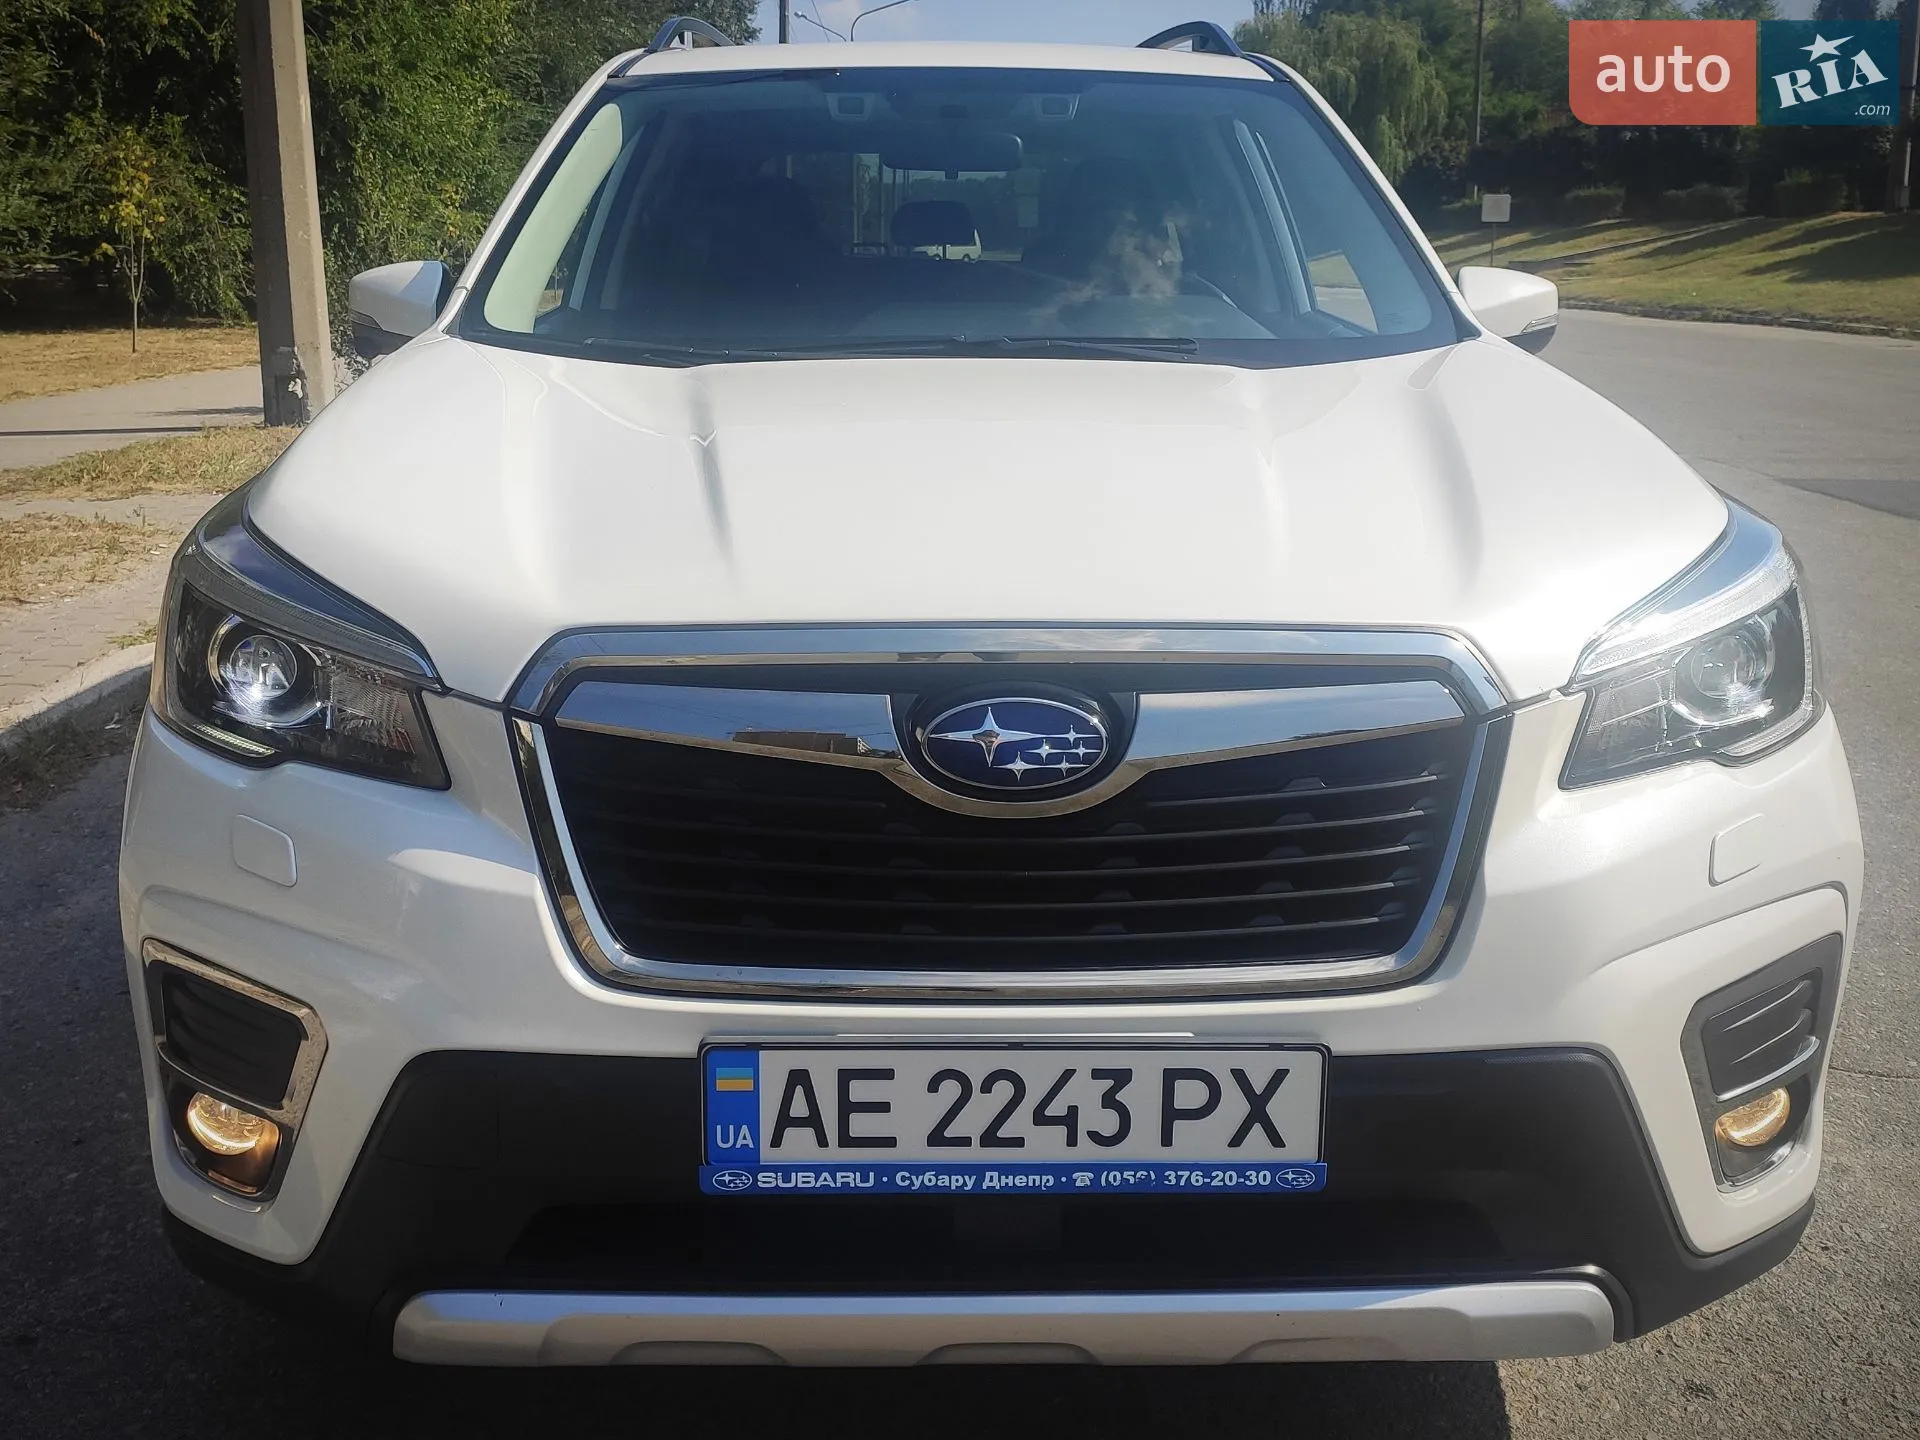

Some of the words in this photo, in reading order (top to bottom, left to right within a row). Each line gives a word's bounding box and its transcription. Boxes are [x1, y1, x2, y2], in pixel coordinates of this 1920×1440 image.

[769, 1068, 897, 1148] AE
[926, 1068, 1133, 1148] 2243
[1160, 1068, 1291, 1148] PX
[716, 1124, 754, 1149] UA
[757, 1171, 875, 1188] SUBARU
[895, 1171, 976, 1190] Субару
[982, 1172, 1054, 1190] Днепр
[1163, 1170, 1271, 1187] 376-20-30
